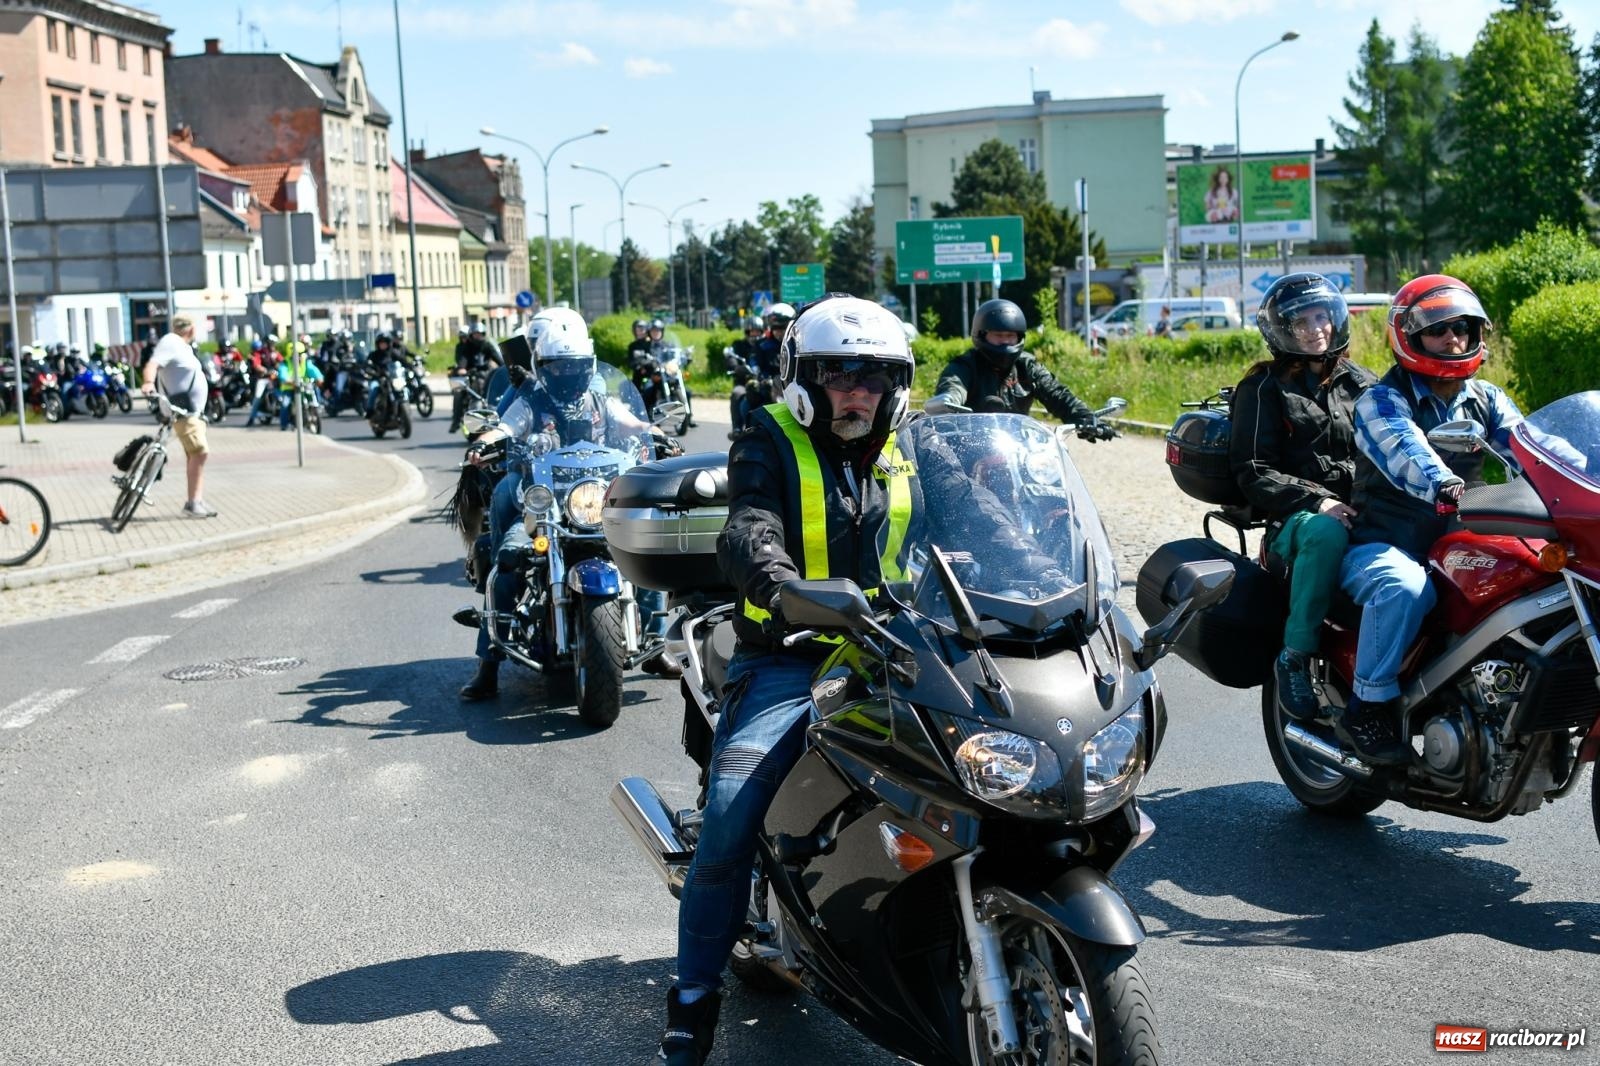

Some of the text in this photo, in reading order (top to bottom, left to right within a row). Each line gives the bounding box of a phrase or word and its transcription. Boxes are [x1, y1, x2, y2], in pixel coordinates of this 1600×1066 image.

[932, 222, 962, 232] Rybnik
[932, 234, 966, 242] Gliwice
[934, 270, 961, 279] Opole
[1447, 555, 1498, 569] REVERE
